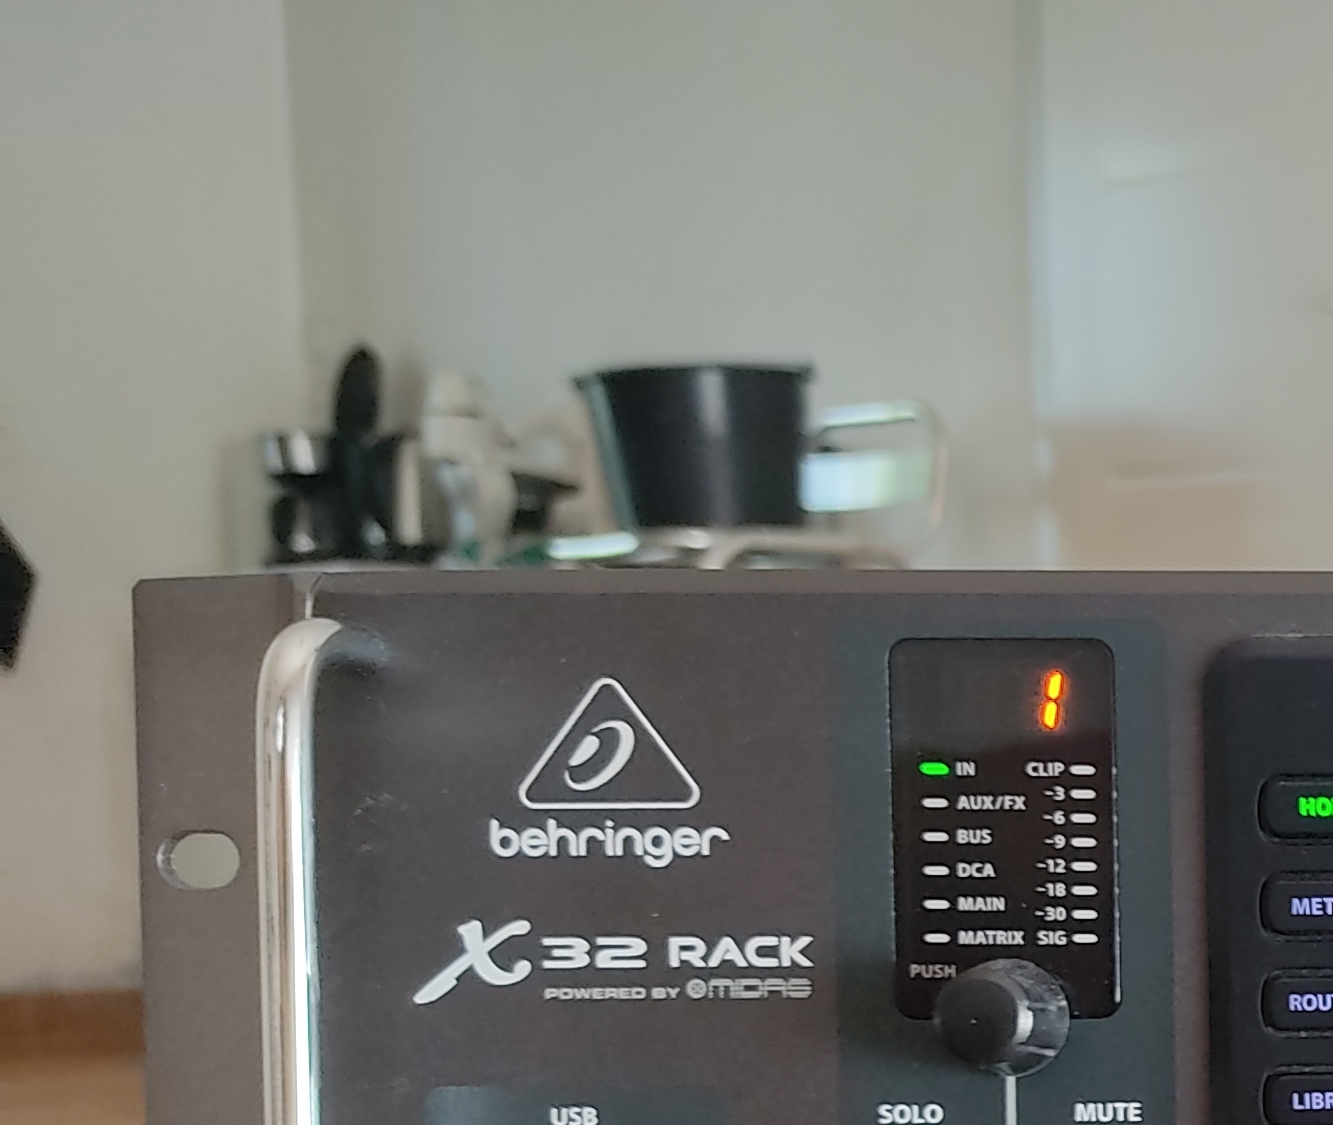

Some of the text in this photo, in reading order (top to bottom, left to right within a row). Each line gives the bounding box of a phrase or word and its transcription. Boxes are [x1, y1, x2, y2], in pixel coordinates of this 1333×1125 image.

[1041, 669, 1064, 730] 1
[955, 761, 976, 777] IN
[1025, 761, 1065, 777] CLIP
[956, 796, 1026, 811] AUX/FX
[489, 819, 730, 868] behringer
[956, 829, 992, 844] BUS
[956, 863, 996, 878] DCA
[957, 896, 1005, 912] MAIN
[957, 930, 1024, 945] MATRIX
[1037, 930, 1067, 946] SIG
[667, 935, 814, 969] RACK
[909, 964, 956, 978] PUSH
[544, 987, 646, 1000] POWERED
[651, 986, 681, 1000] BY
[877, 1102, 943, 1125] SOLO
[1074, 1101, 1142, 1124] MUTE
